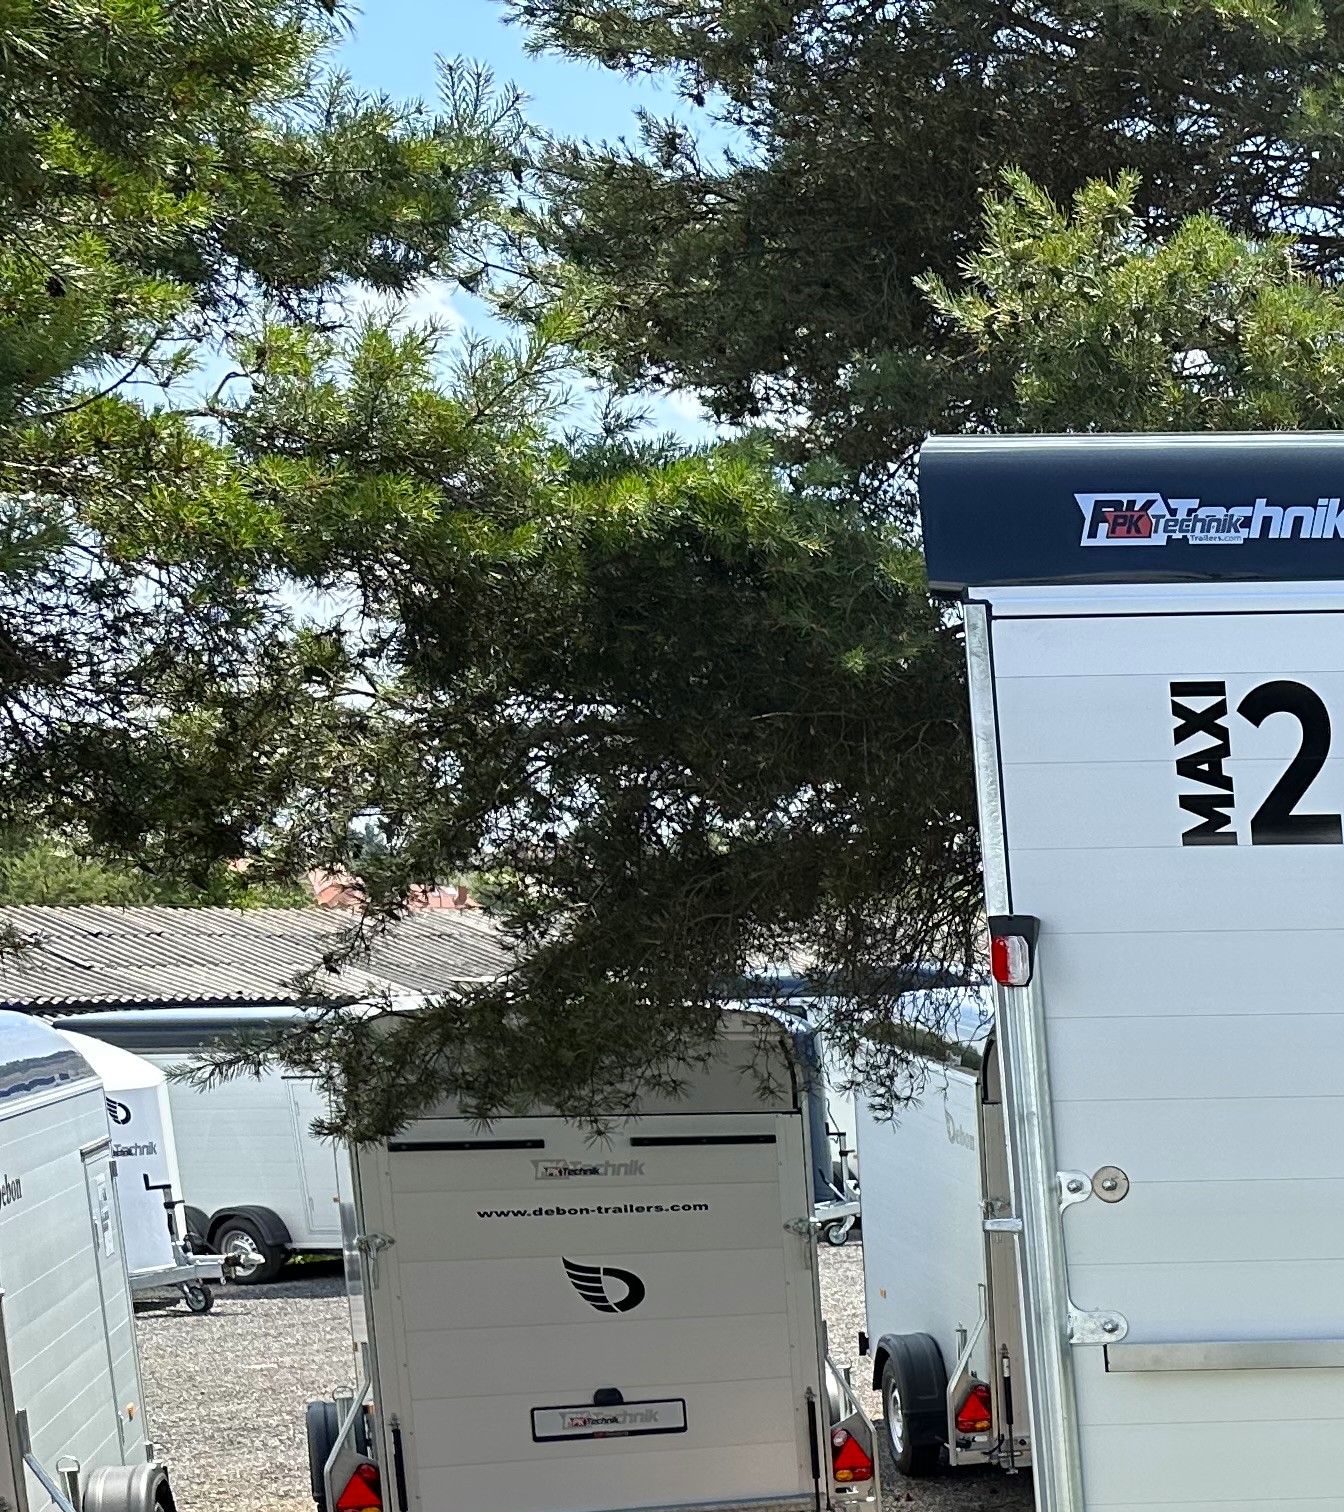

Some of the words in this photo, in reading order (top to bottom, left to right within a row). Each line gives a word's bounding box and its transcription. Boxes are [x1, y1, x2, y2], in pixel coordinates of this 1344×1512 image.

[1110, 514, 1146, 535] PK
[1151, 513, 1243, 534] Technik
[1170, 681, 1238, 846] MAXI
[1236, 680, 1344, 846] 2
[0, 1174, 22, 1208] ebon
[477, 1202, 709, 1218] www.debon-trailers.com
